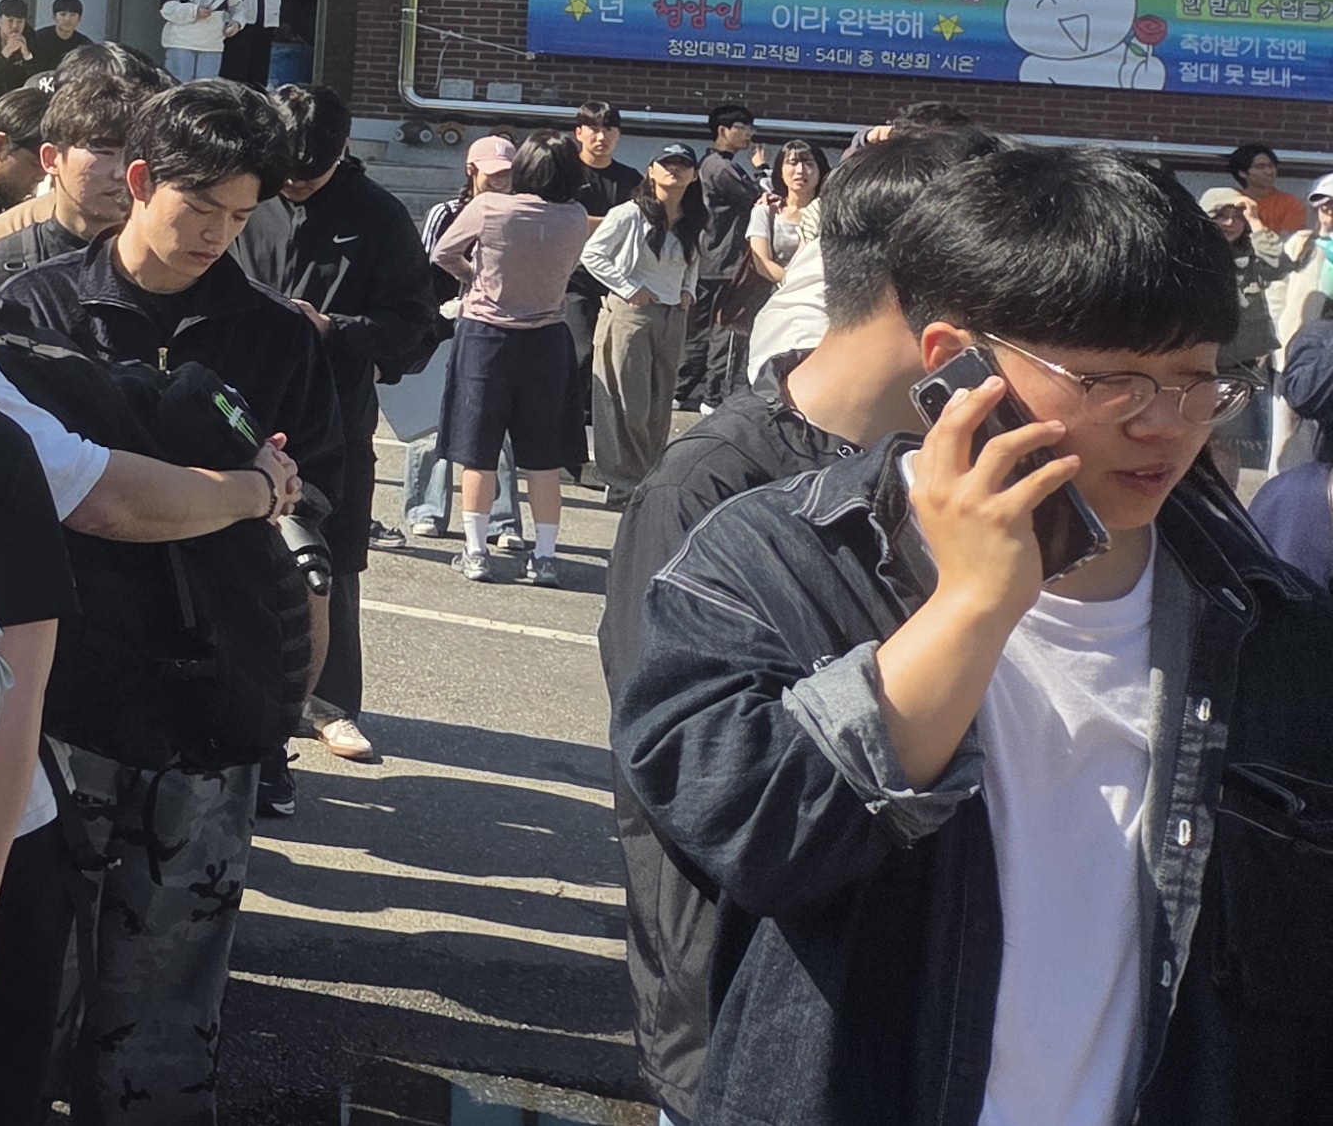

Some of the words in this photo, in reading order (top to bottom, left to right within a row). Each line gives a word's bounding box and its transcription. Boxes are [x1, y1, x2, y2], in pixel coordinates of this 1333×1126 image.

[771, 4, 830, 34] 이라
[836, 7, 924, 40] 완벽해
[667, 39, 747, 60] 청암대학교
[751, 42, 801, 63] 교직원
[815, 48, 853, 66] 54대
[880, 50, 931, 70] 학생회
[1180, 32, 1260, 59] 축하받기
[1266, 37, 1307, 61] 전엔
[1179, 61, 1219, 84] 절대
[1224, 63, 1245, 85] 못
